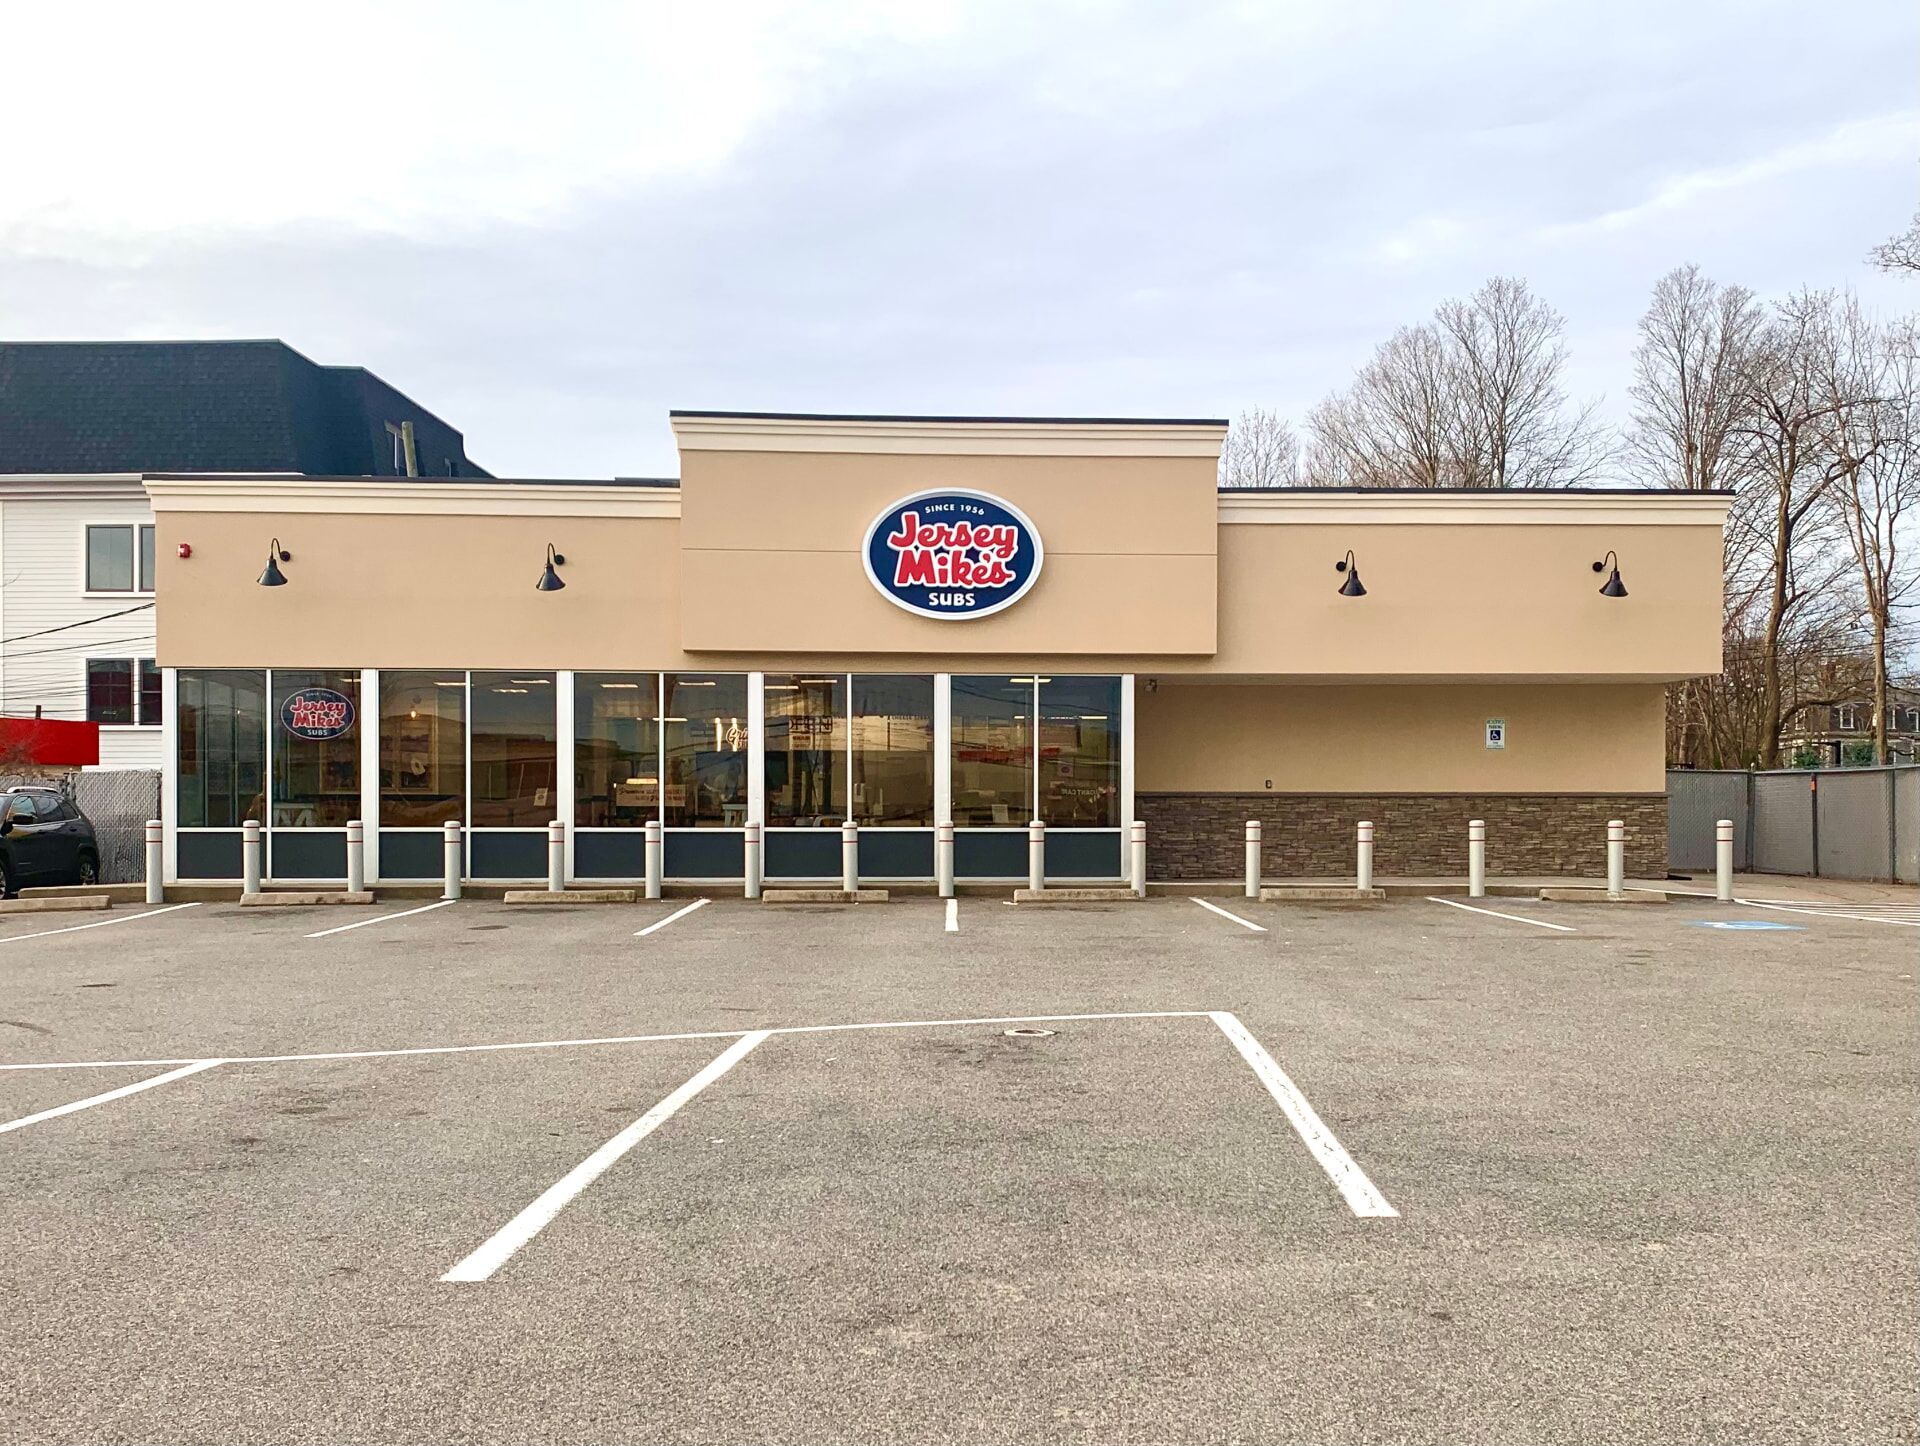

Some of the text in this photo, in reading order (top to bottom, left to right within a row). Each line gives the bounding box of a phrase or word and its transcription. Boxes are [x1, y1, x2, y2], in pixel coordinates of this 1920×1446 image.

[924, 503, 985, 516] SINCE 1956
[889, 513, 1016, 560] Jersey
[895, 549, 1014, 587] Mike's
[928, 592, 976, 607] SUBS
[290, 696, 346, 717] Jersey
